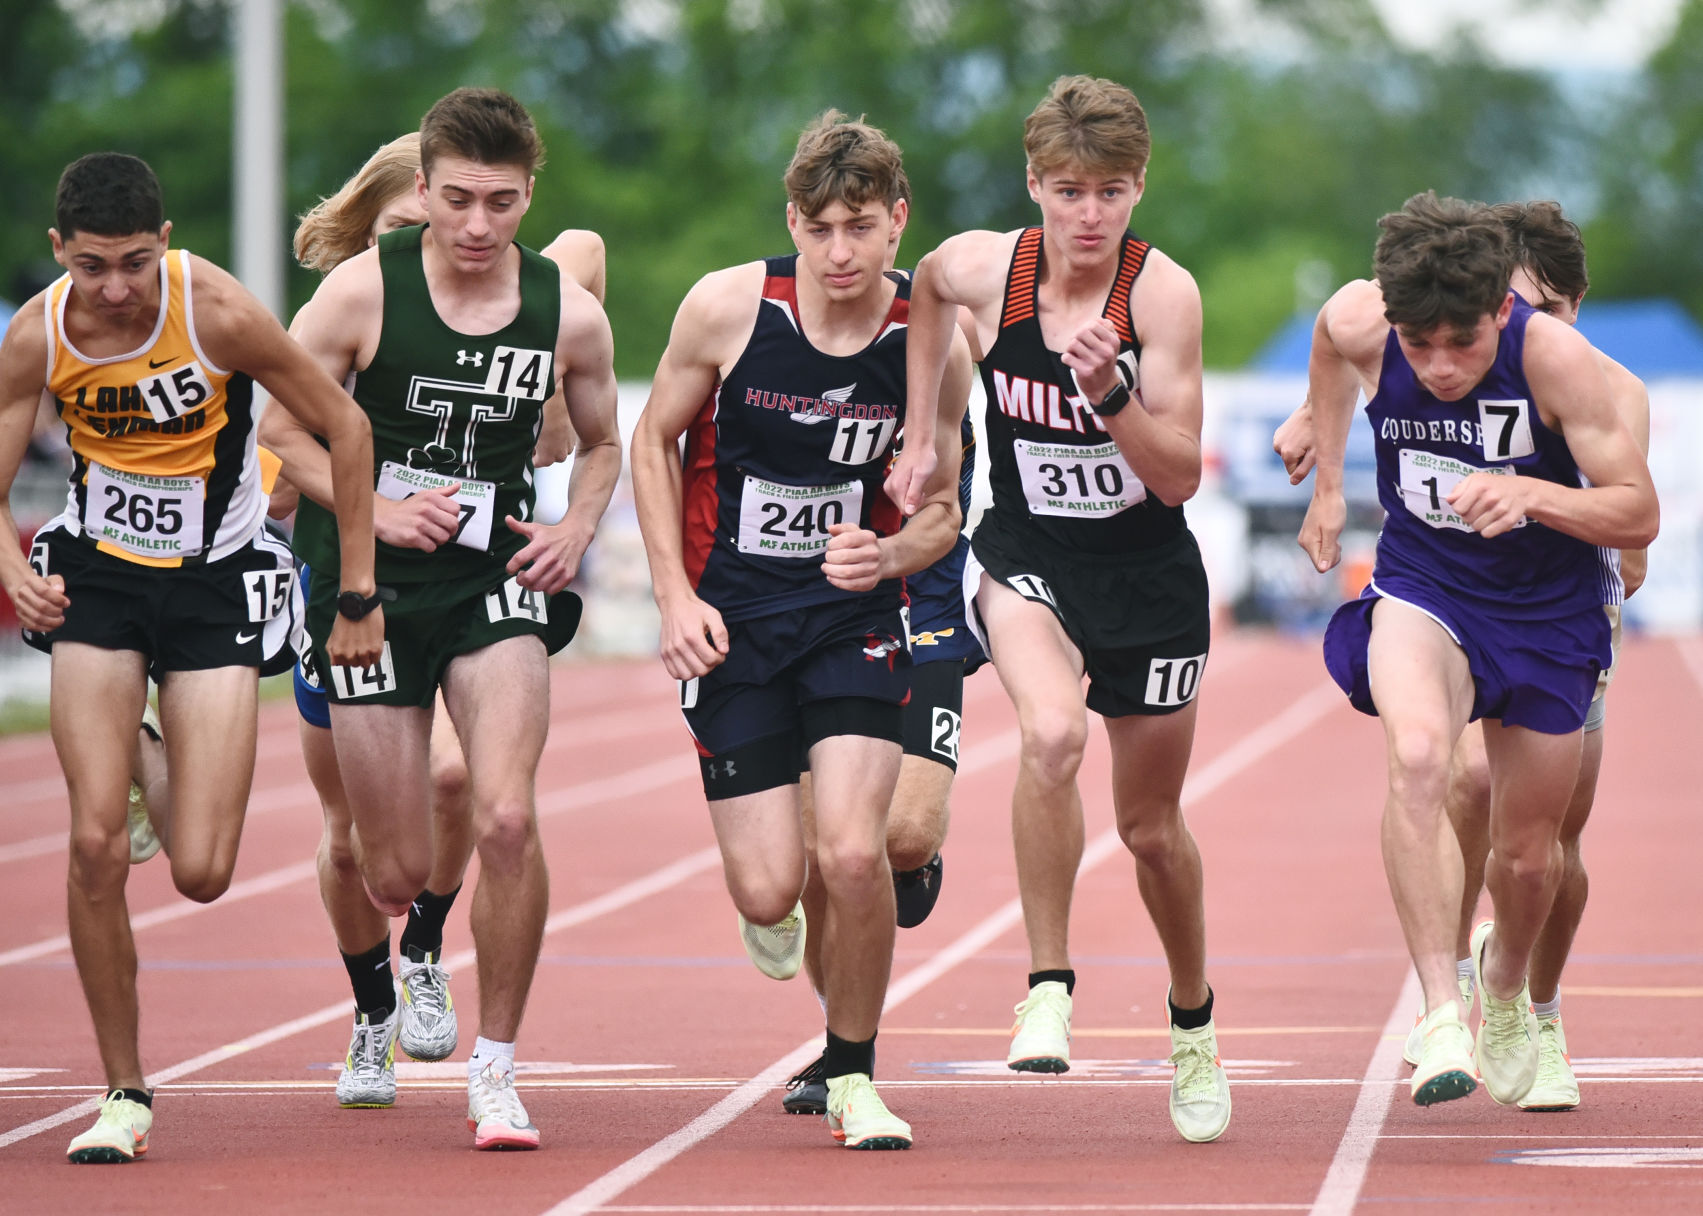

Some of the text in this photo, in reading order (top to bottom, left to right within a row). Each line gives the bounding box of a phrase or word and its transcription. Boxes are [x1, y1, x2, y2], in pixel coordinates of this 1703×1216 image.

[148, 367, 207, 418] 15
[497, 351, 541, 398] 14
[745, 387, 897, 421] HUNTINGDON
[993, 368, 1106, 434] MILT
[74, 408, 206, 438] EHMAN
[842, 421, 884, 463] 11
[1485, 405, 1520, 457] 7
[396, 467, 422, 481] 2022
[423, 476, 446, 487] PIAA
[461, 482, 485, 492] BOYS
[758, 481, 783, 493] 2022
[785, 487, 809, 496] PIAA
[1039, 464, 1123, 497] 310
[104, 485, 183, 535] 265
[760, 500, 844, 538] 240
[1067, 499, 1128, 512] ATHLETIC
[121, 533, 182, 550] ATHLETIC
[780, 538, 832, 552] ATHLET
[252, 572, 291, 620] 15
[490, 583, 540, 621] 14
[1155, 659, 1199, 703] 10
